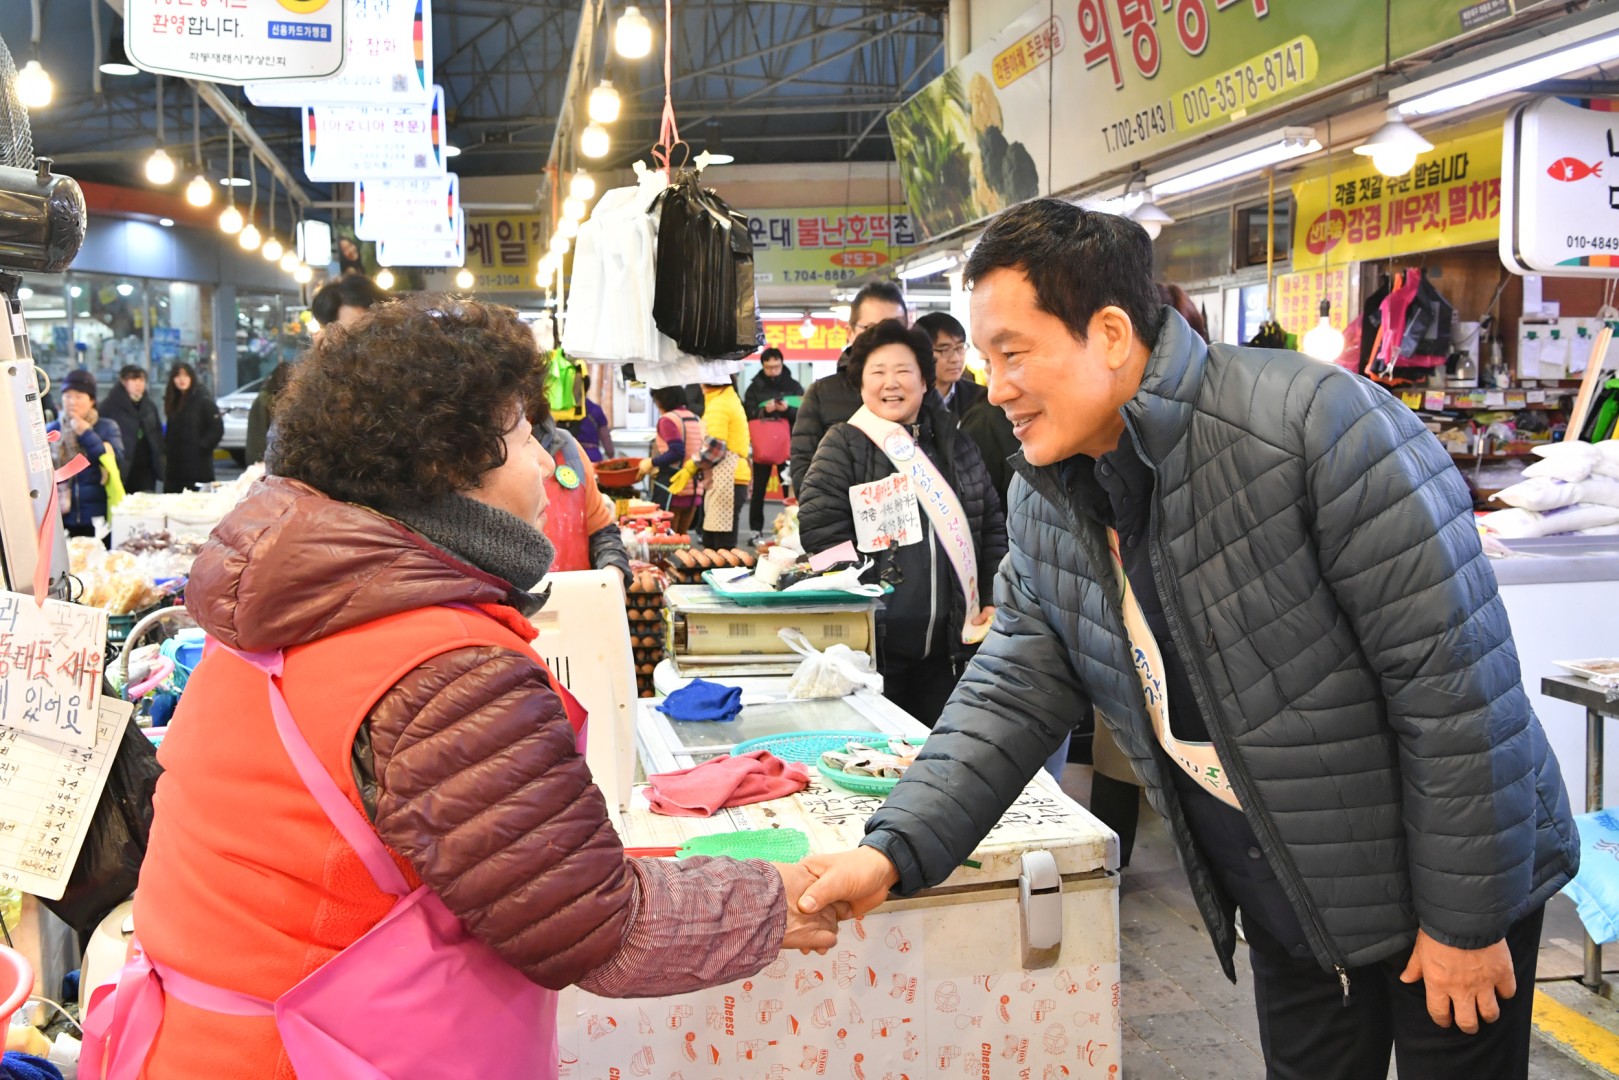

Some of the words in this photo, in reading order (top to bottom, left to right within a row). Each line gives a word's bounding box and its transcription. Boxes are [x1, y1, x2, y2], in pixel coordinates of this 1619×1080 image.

[153, 14, 245, 38] 환영합니다.
[271, 23, 329, 39] 신용카드가맹점
[1101, 104, 1167, 154] T.702-8743
[1182, 41, 1309, 125] 010-3578-8747
[322, 120, 385, 133] (아로니아
[393, 120, 427, 133] 전문)
[1335, 180, 1357, 207] 각종
[1359, 175, 1384, 202] 젓갈
[1414, 152, 1470, 190] 받습니다
[748, 217, 792, 247] 운대
[797, 214, 917, 247] 불난호떡집
[1347, 203, 1382, 244] 강경
[860, 507, 877, 523] 각종
[51, 603, 99, 649] 꽃게
[57, 648, 102, 710] 새우
[23, 687, 81, 734] 있어요
[907, 978, 917, 1003] ONION
[724, 995, 736, 1036] Cheese
[817, 1050, 828, 1075] ONION
[981, 1042, 992, 1080] Cheese
[1018, 1039, 1029, 1064] ONION
